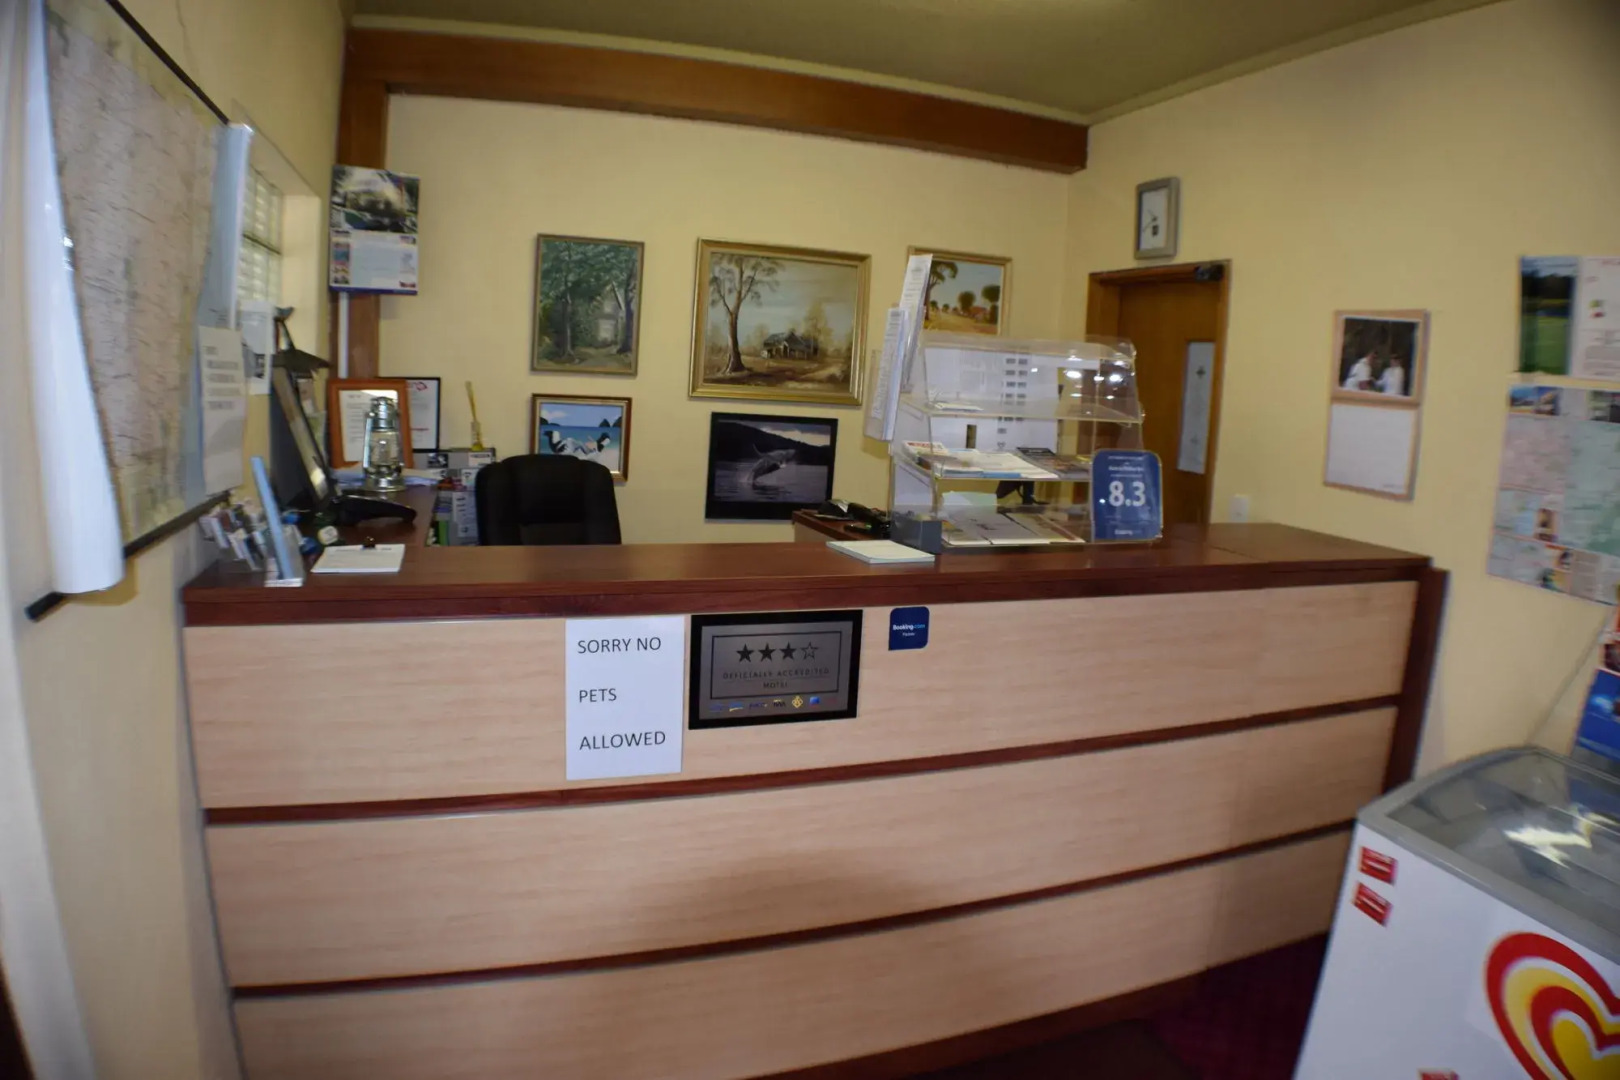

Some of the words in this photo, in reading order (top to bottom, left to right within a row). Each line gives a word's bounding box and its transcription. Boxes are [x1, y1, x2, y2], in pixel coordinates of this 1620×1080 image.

[1108, 480, 1146, 507] 8.3
[577, 638, 632, 654] SORRY
[636, 636, 662, 652] NO
[722, 670, 773, 680] OFFICIALLY
[777, 667, 830, 678] ACCREDITED
[579, 687, 618, 703] PETS
[579, 730, 666, 751] ALLOWED
